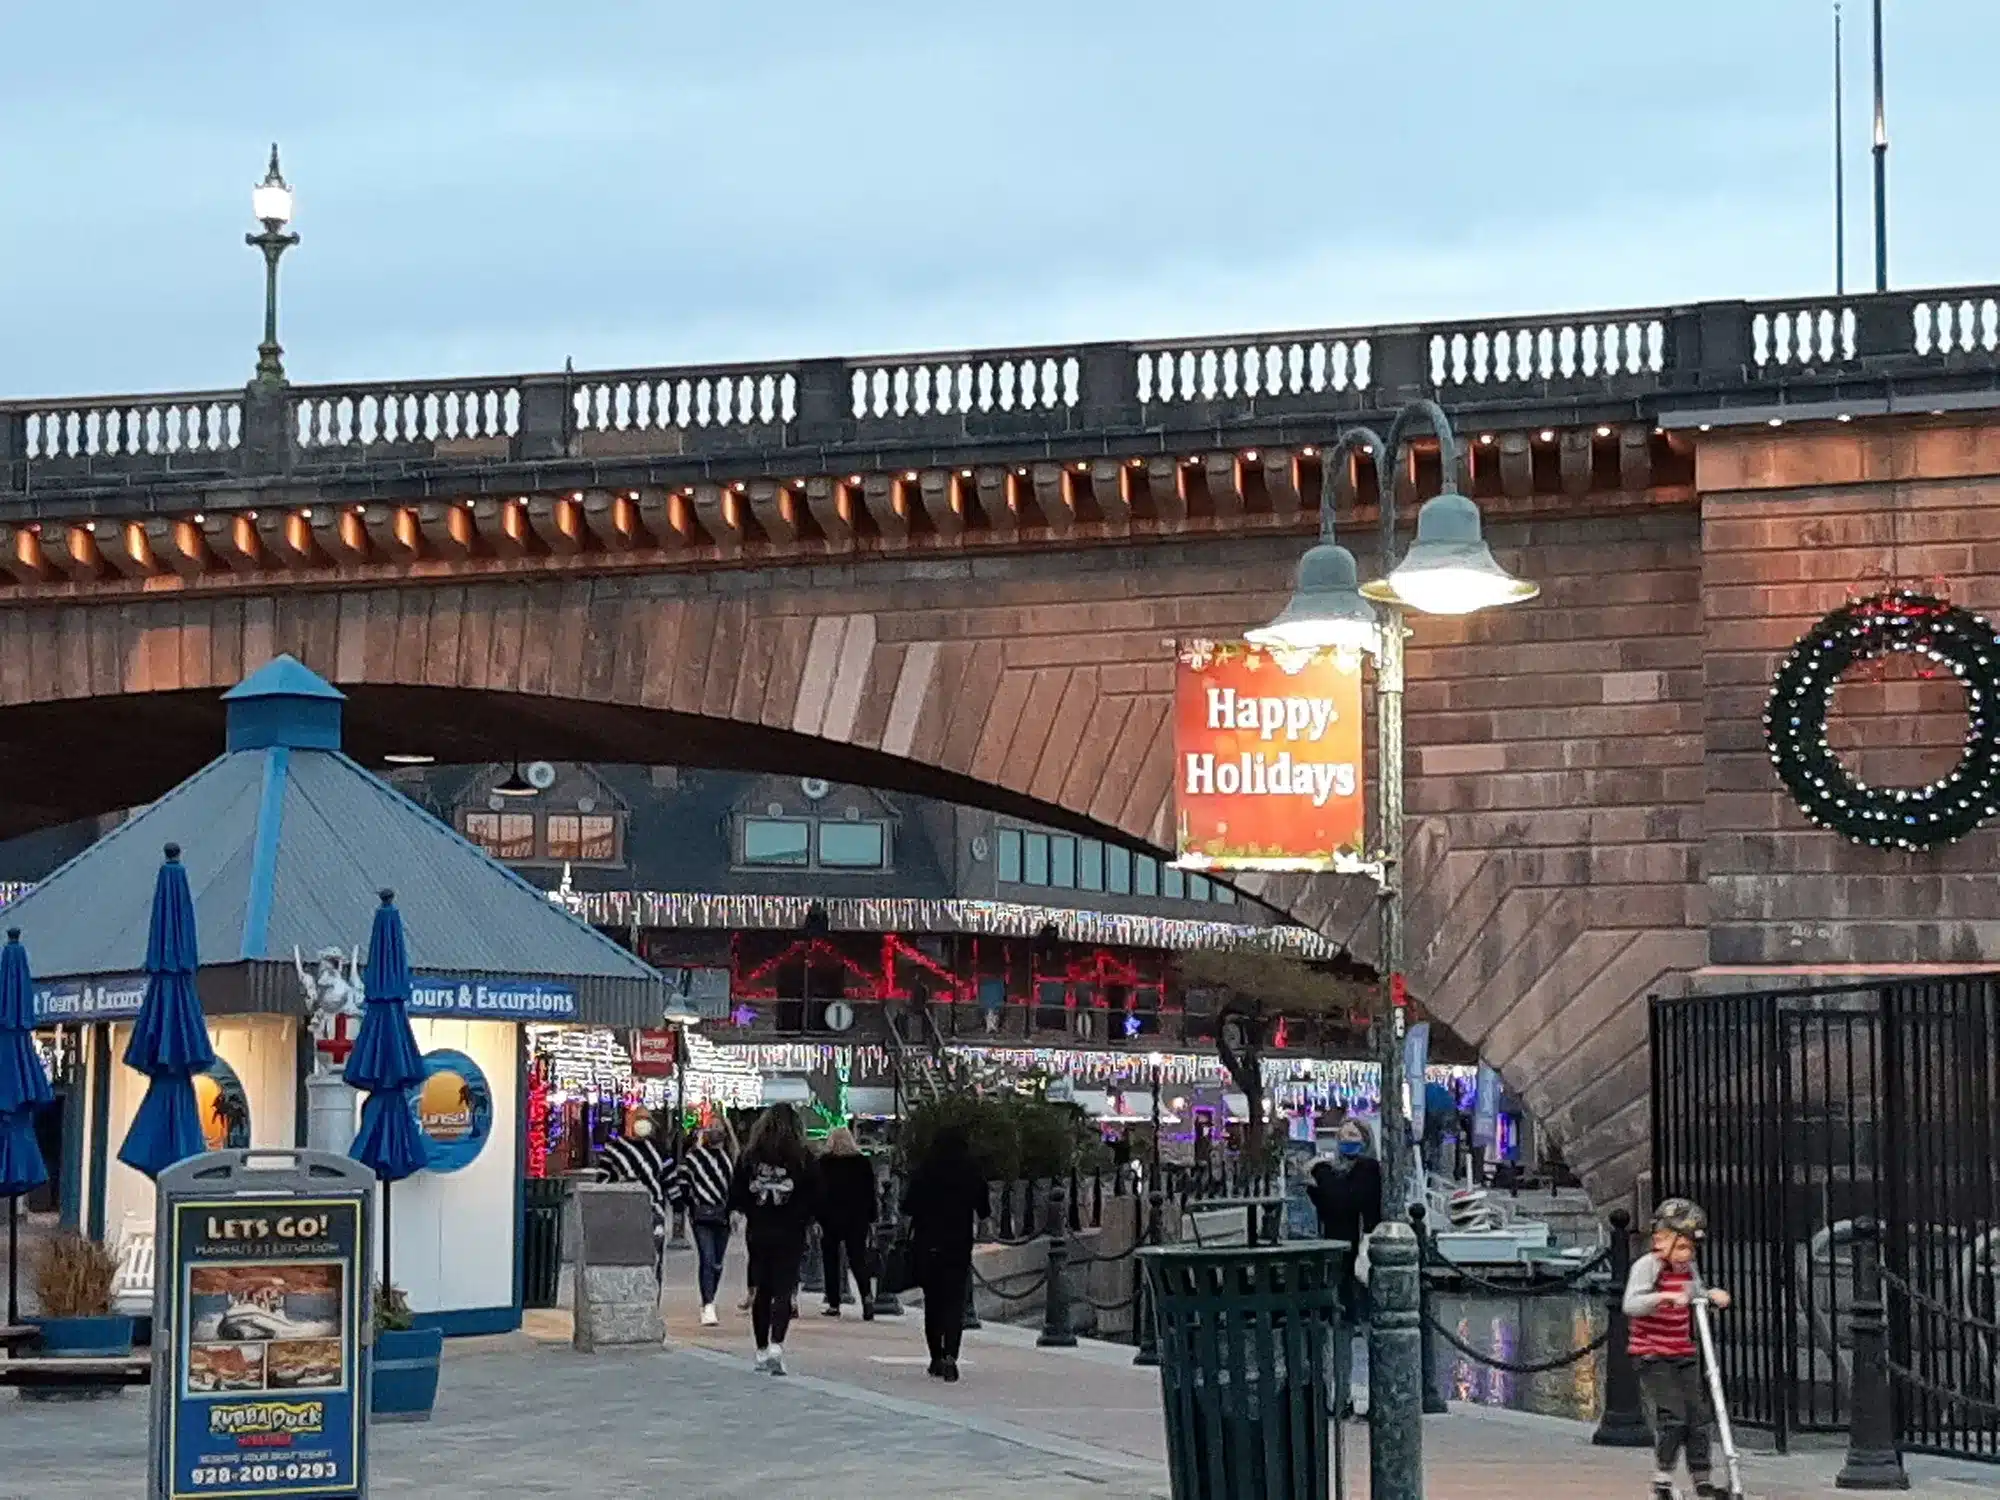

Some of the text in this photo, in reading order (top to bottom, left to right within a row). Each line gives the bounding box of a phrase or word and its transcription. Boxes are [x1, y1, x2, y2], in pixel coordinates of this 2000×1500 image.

[1206, 687, 1334, 741] Happy
[1185, 751, 1356, 808] Holidays
[41, 990, 80, 1014] Tours
[82, 986, 95, 1011] &
[458, 984, 473, 1009] &
[476, 985, 575, 1013] Excursions
[207, 1214, 329, 1239] LETS GO!
[210, 1408, 322, 1432] RUBBA DUCK
